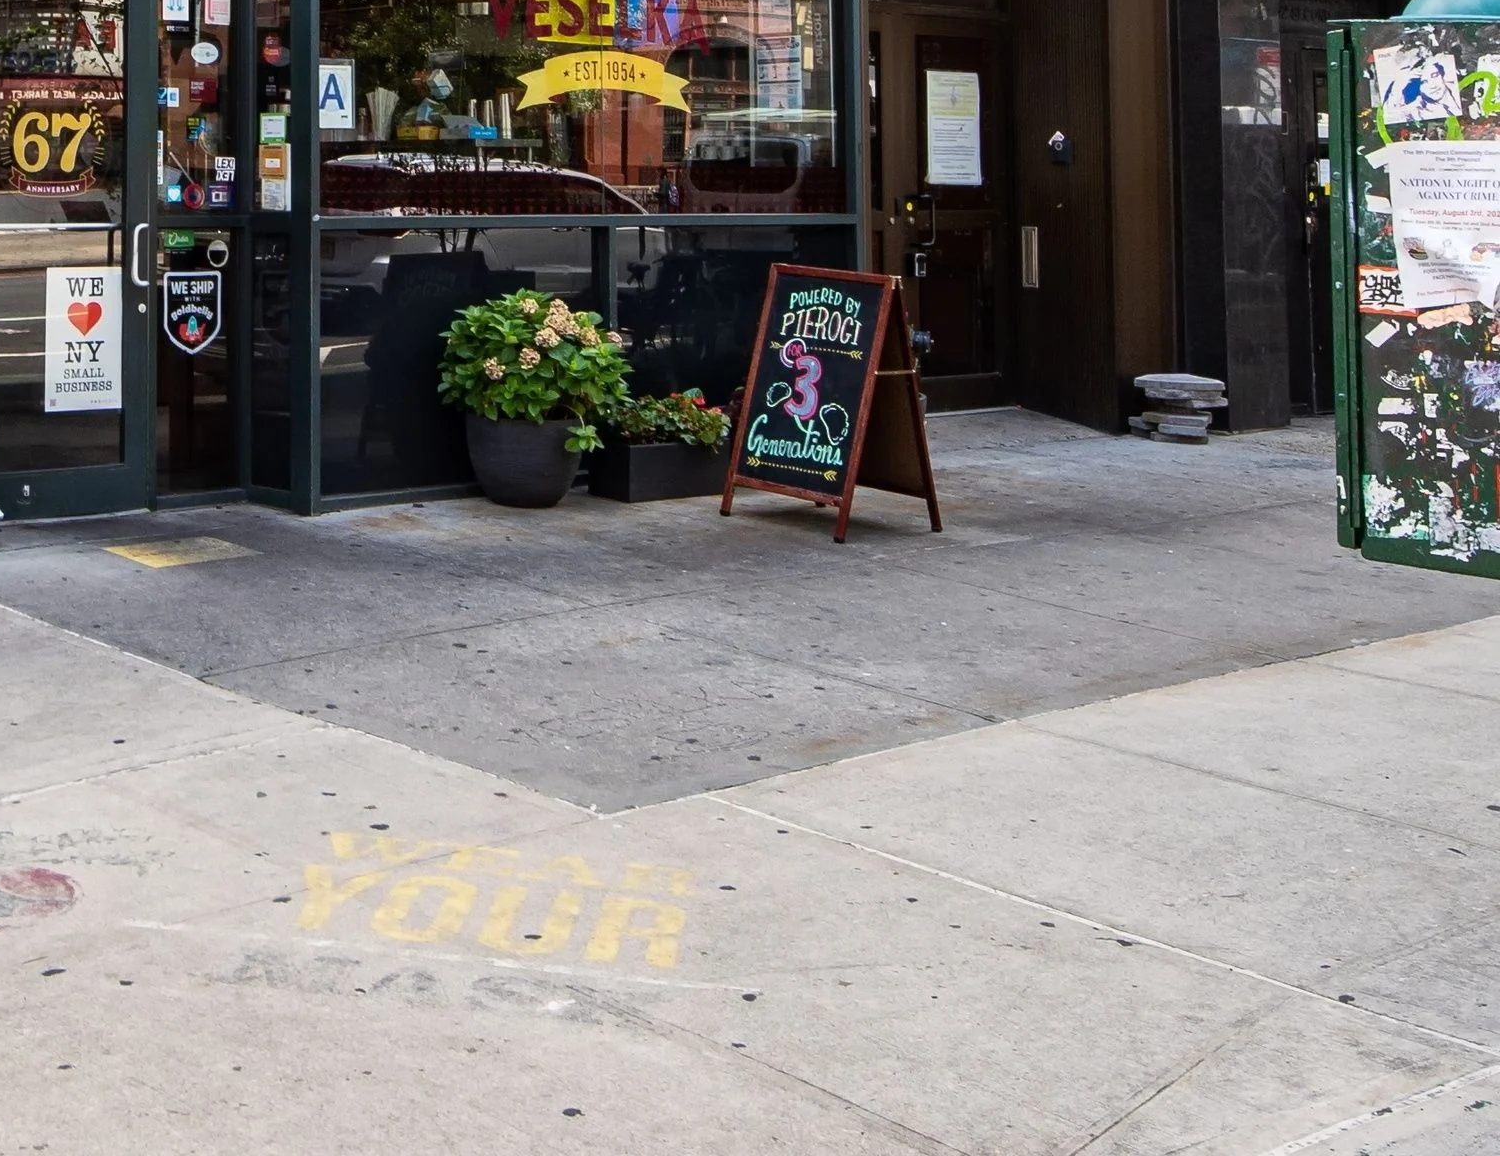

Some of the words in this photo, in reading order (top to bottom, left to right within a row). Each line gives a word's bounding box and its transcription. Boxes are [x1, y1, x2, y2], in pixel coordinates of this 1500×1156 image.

[575, 61, 601, 82] EST.
[605, 61, 636, 83] 1954
[319, 73, 345, 110] A
[13, 111, 92, 173] 67
[26, 184, 80, 193] ANNIVERSARY
[1400, 178, 1452, 188] NATIONAL
[1457, 179, 1490, 189] NIGHT
[1417, 191, 1462, 201] AGAINST
[1463, 191, 1499, 202] CRIME
[1442, 209, 1468, 218] August
[66, 277, 104, 298] WE
[171, 280, 188, 295] WE
[190, 280, 214, 295] SHIP
[170, 304, 214, 321] goldbelly
[789, 287, 843, 310] POWERED
[845, 297, 861, 318] BY
[779, 306, 863, 346] PIEROGI
[64, 340, 105, 363] NY
[63, 368, 105, 380] SMALL
[55, 380, 113, 394] BUSINESS
[783, 354, 823, 421] 3
[747, 414, 844, 467] Generations
[295, 863, 688, 970] YOUR
